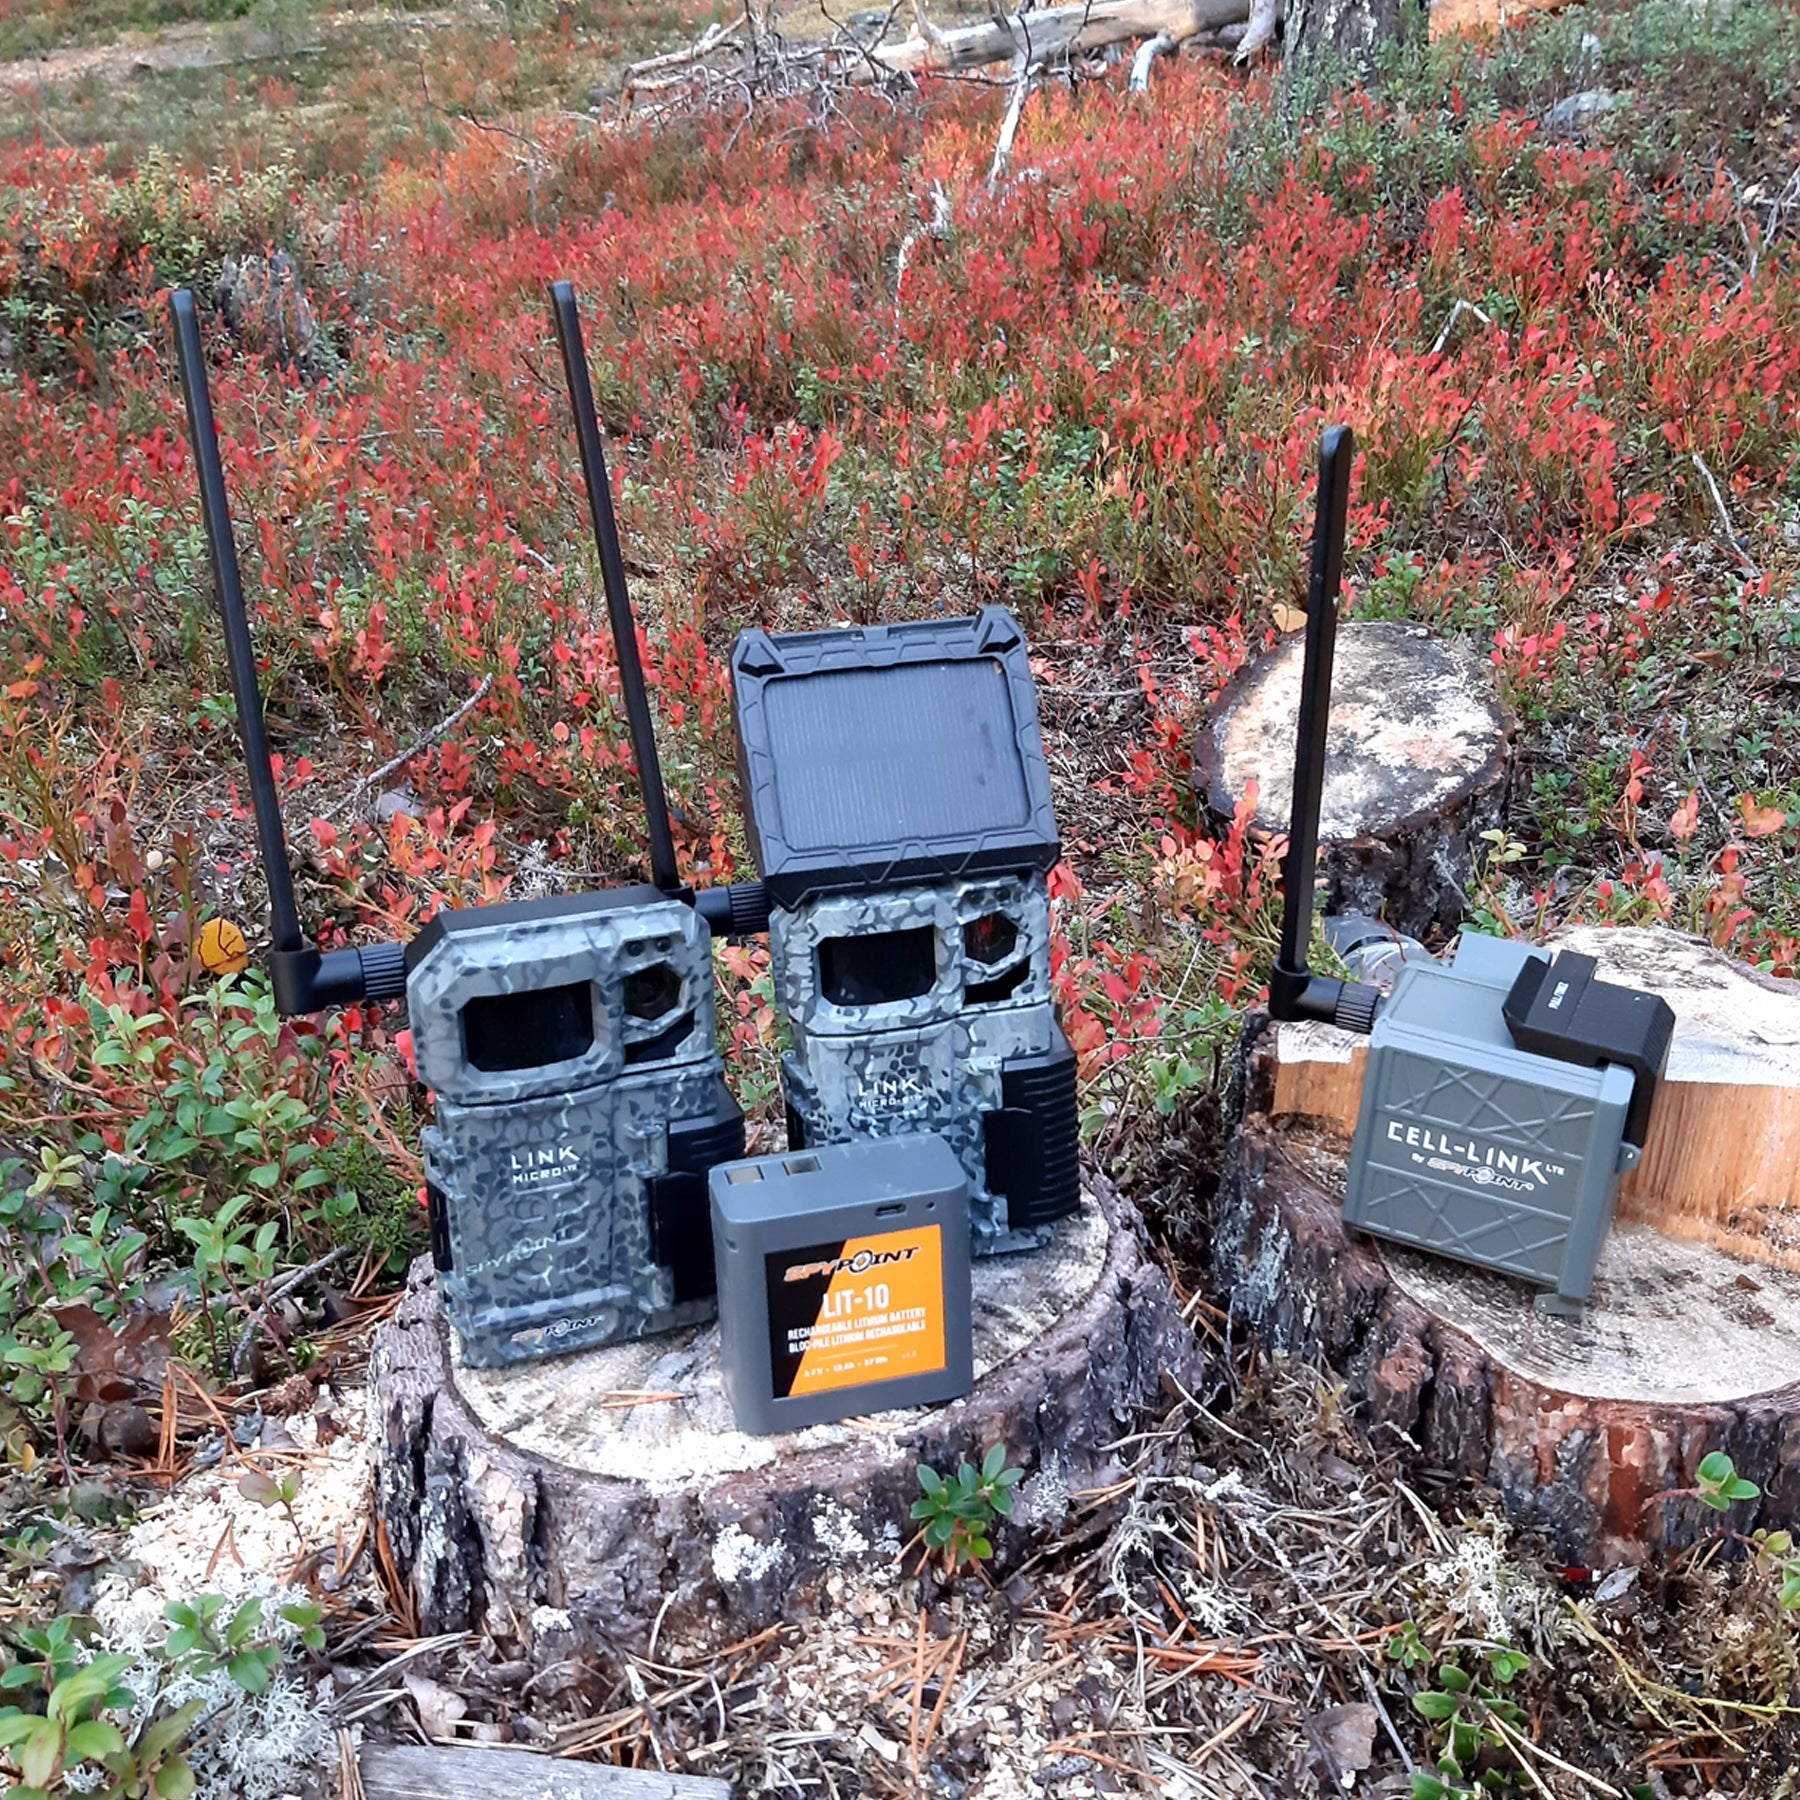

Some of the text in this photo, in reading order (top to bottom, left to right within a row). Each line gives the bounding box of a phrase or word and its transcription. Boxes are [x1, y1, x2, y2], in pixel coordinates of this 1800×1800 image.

[858, 1078, 922, 1096] LINK
[511, 1145, 580, 1170] LINK
[1387, 1121, 1565, 1185] CELL-LINK LTE
[513, 1167, 561, 1184] MICRO
[784, 1246, 921, 1282] SPYPOINT
[822, 1283, 890, 1318] LIT-10
[788, 1307, 926, 1341] RECHARGEABLE LITHIUM BATTERY
[832, 1330, 864, 1347] LITHIUM
[866, 1319, 926, 1339] RECHARGEABLE
